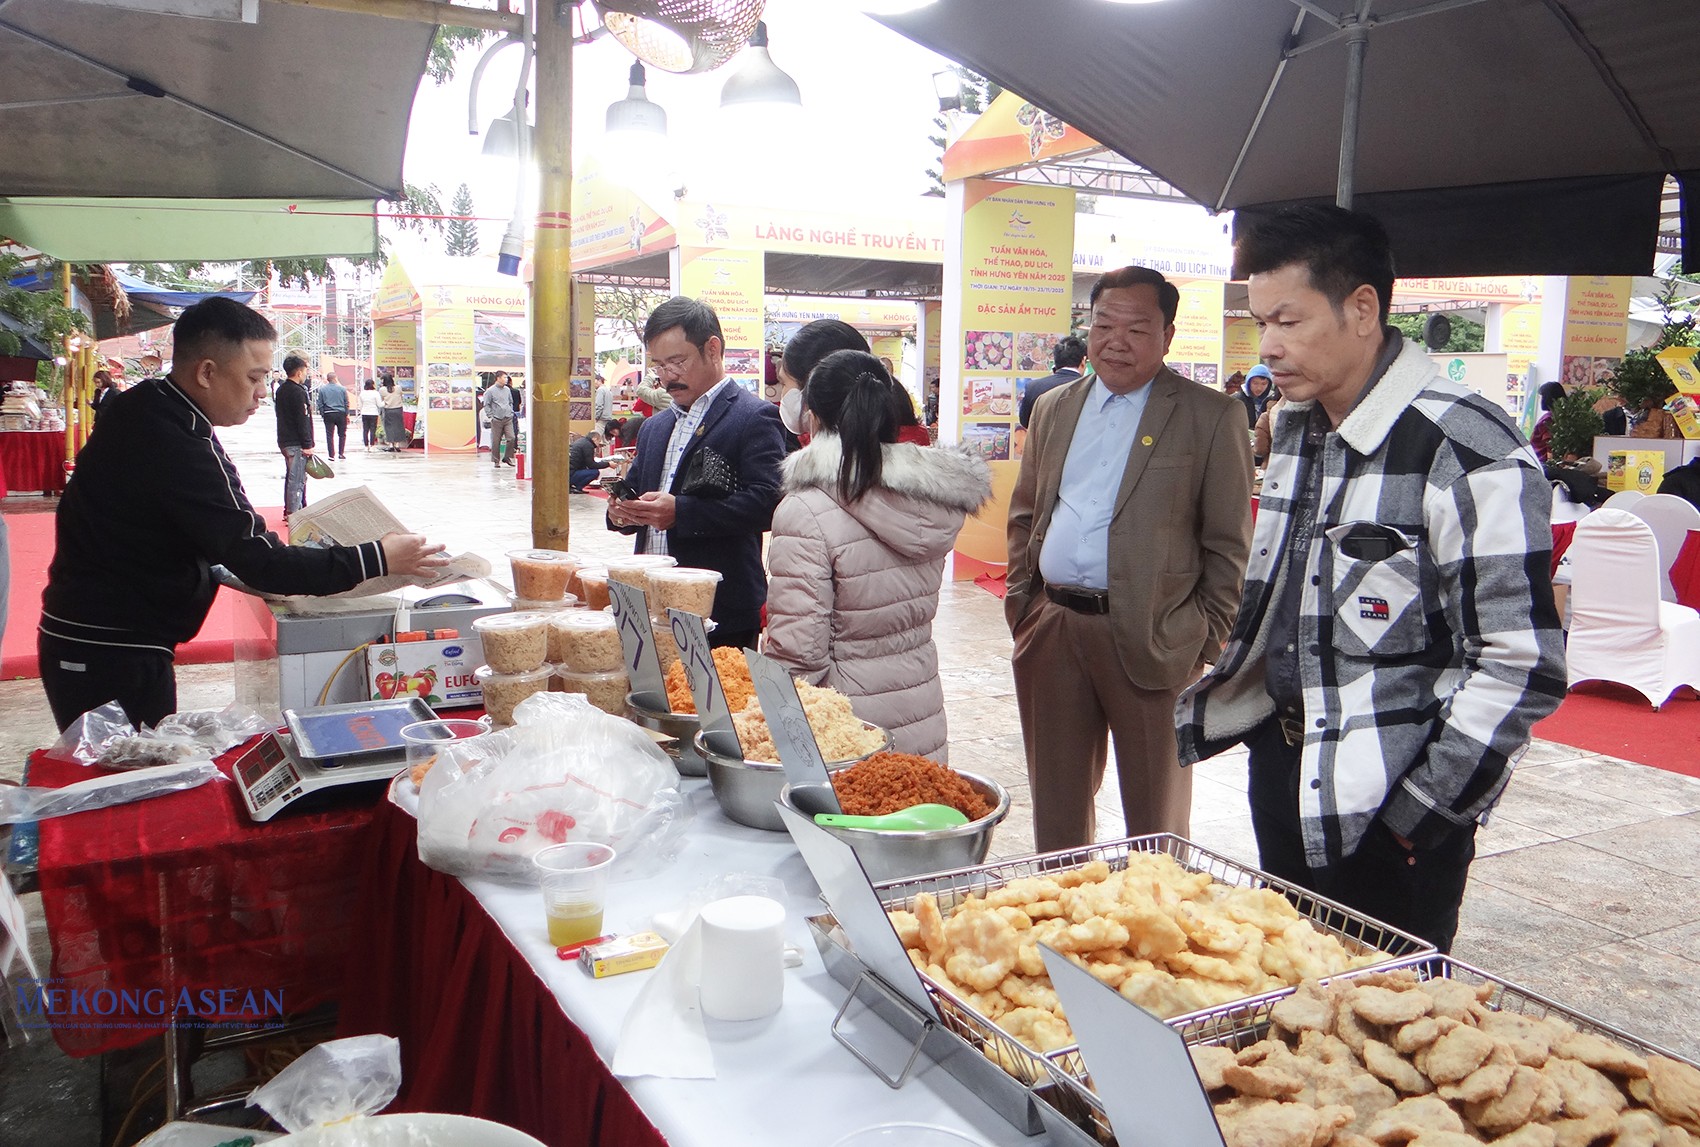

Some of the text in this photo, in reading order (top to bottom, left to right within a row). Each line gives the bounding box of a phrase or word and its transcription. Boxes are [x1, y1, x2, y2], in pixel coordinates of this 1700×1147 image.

[756, 222, 944, 251] LÀNG NGHỀ TRUYỀN T
[990, 244, 1048, 257] TUẦN VĂN HÓA,
[984, 256, 998, 266] THỂ
[1002, 259, 1022, 268] THAO,
[1036, 261, 1053, 270] LỊCH
[1176, 260, 1186, 272] DU
[970, 268, 988, 276] TỈNH
[990, 270, 1011, 278] HƯNG
[1014, 271, 1028, 280] YÊN
[1030, 272, 1046, 280] NĂM
[466, 295, 502, 304] KHÔNG
[978, 302, 1056, 316] ĐẶC SẢN ẨM THỰC
[884, 311, 910, 321] KHÔNG
